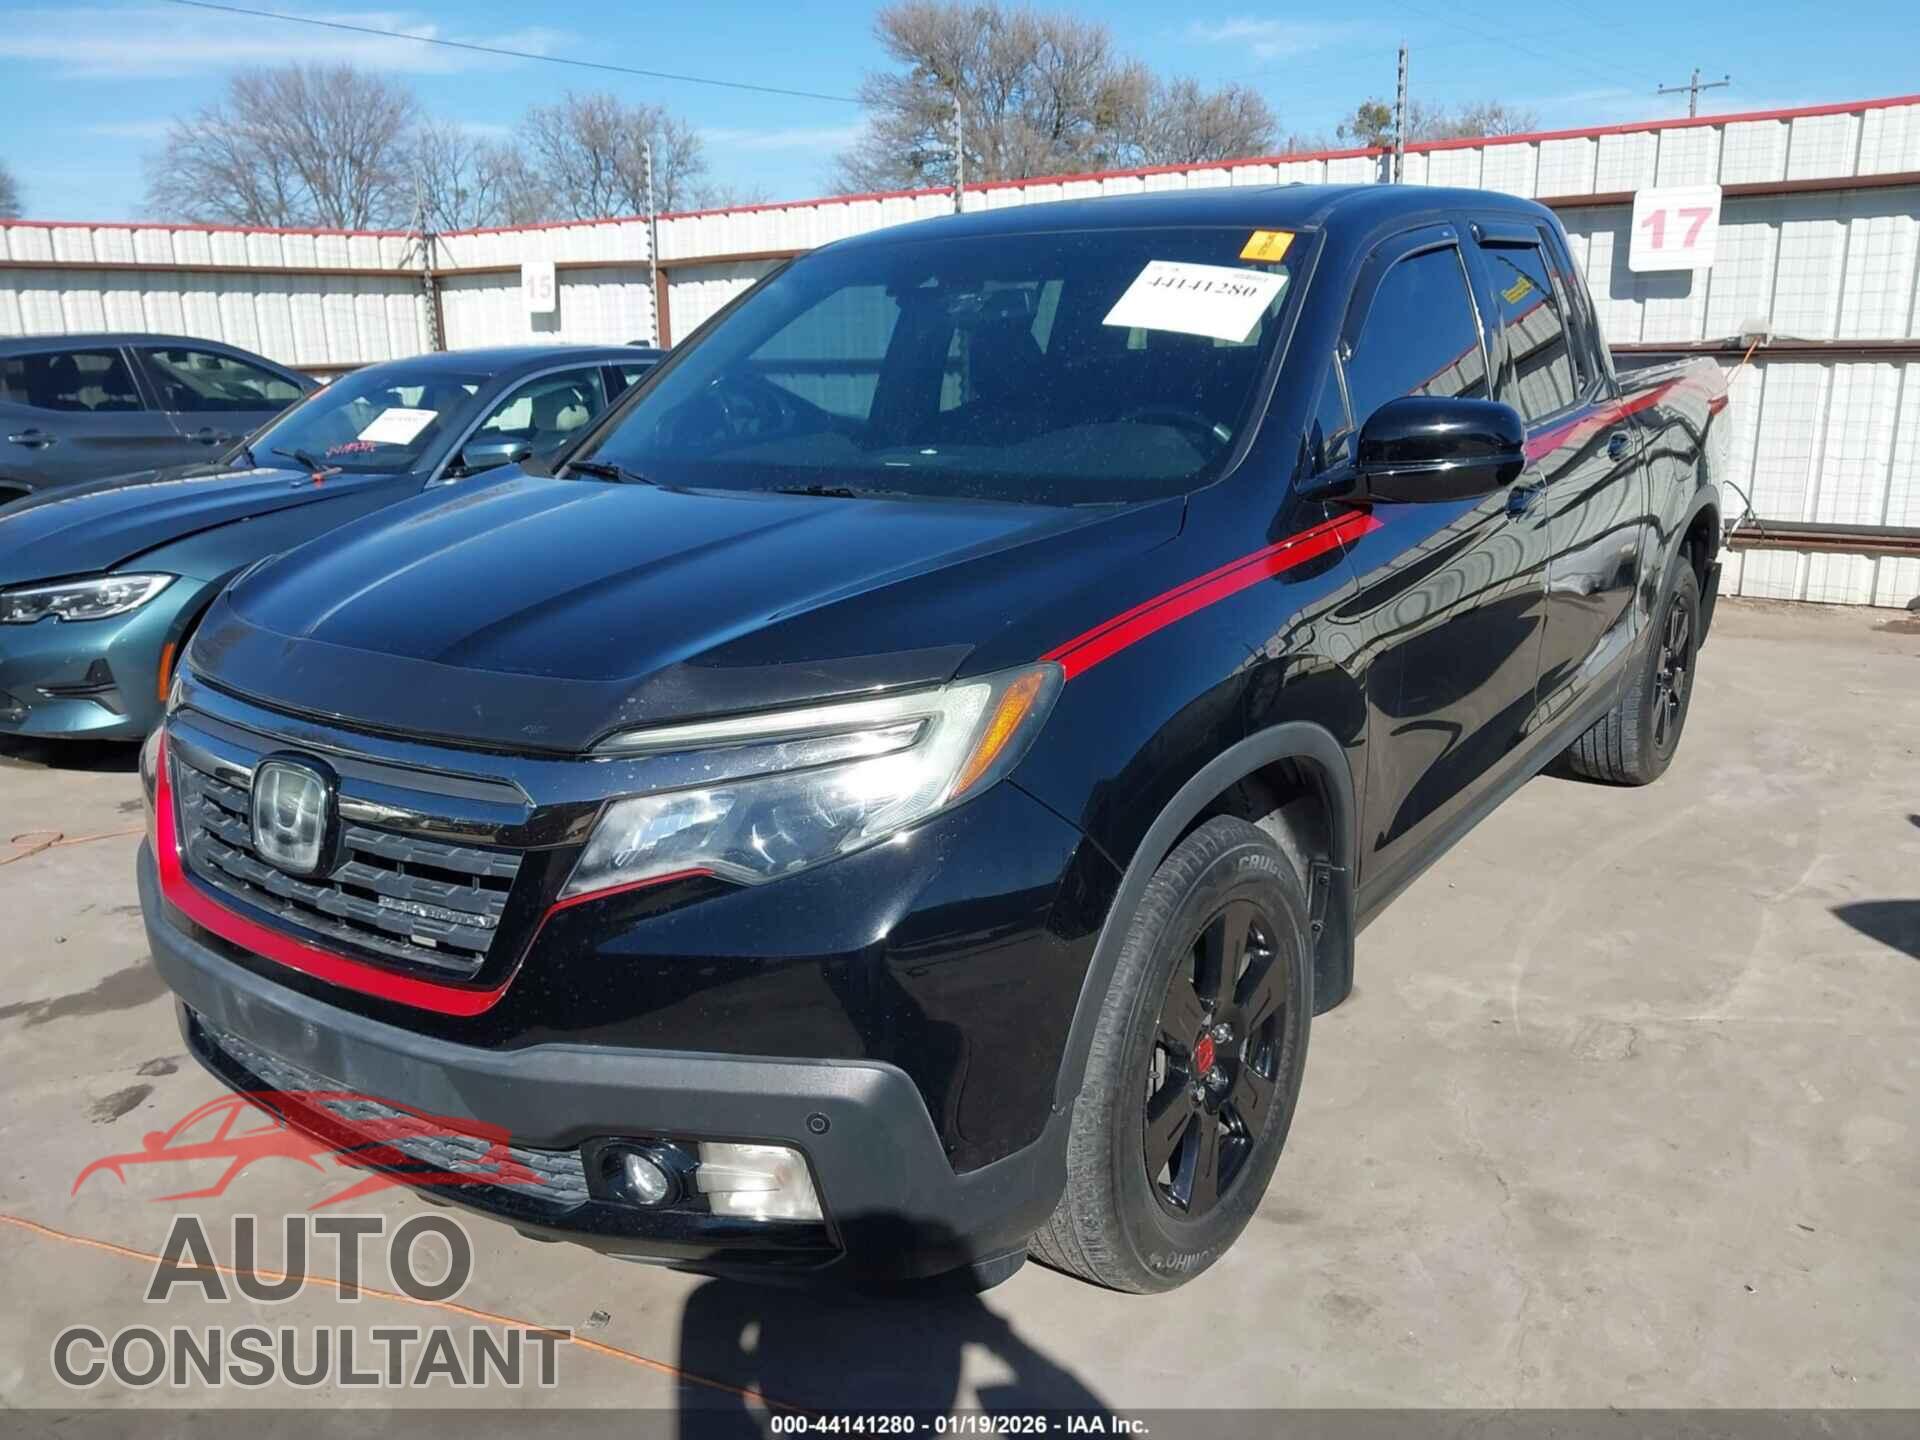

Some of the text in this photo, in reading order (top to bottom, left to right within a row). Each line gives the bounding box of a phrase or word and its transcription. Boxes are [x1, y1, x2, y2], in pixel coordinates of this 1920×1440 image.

[1641, 206, 1714, 250] 17
[528, 274, 552, 299] 15
[1147, 275, 1258, 298] 44141280
